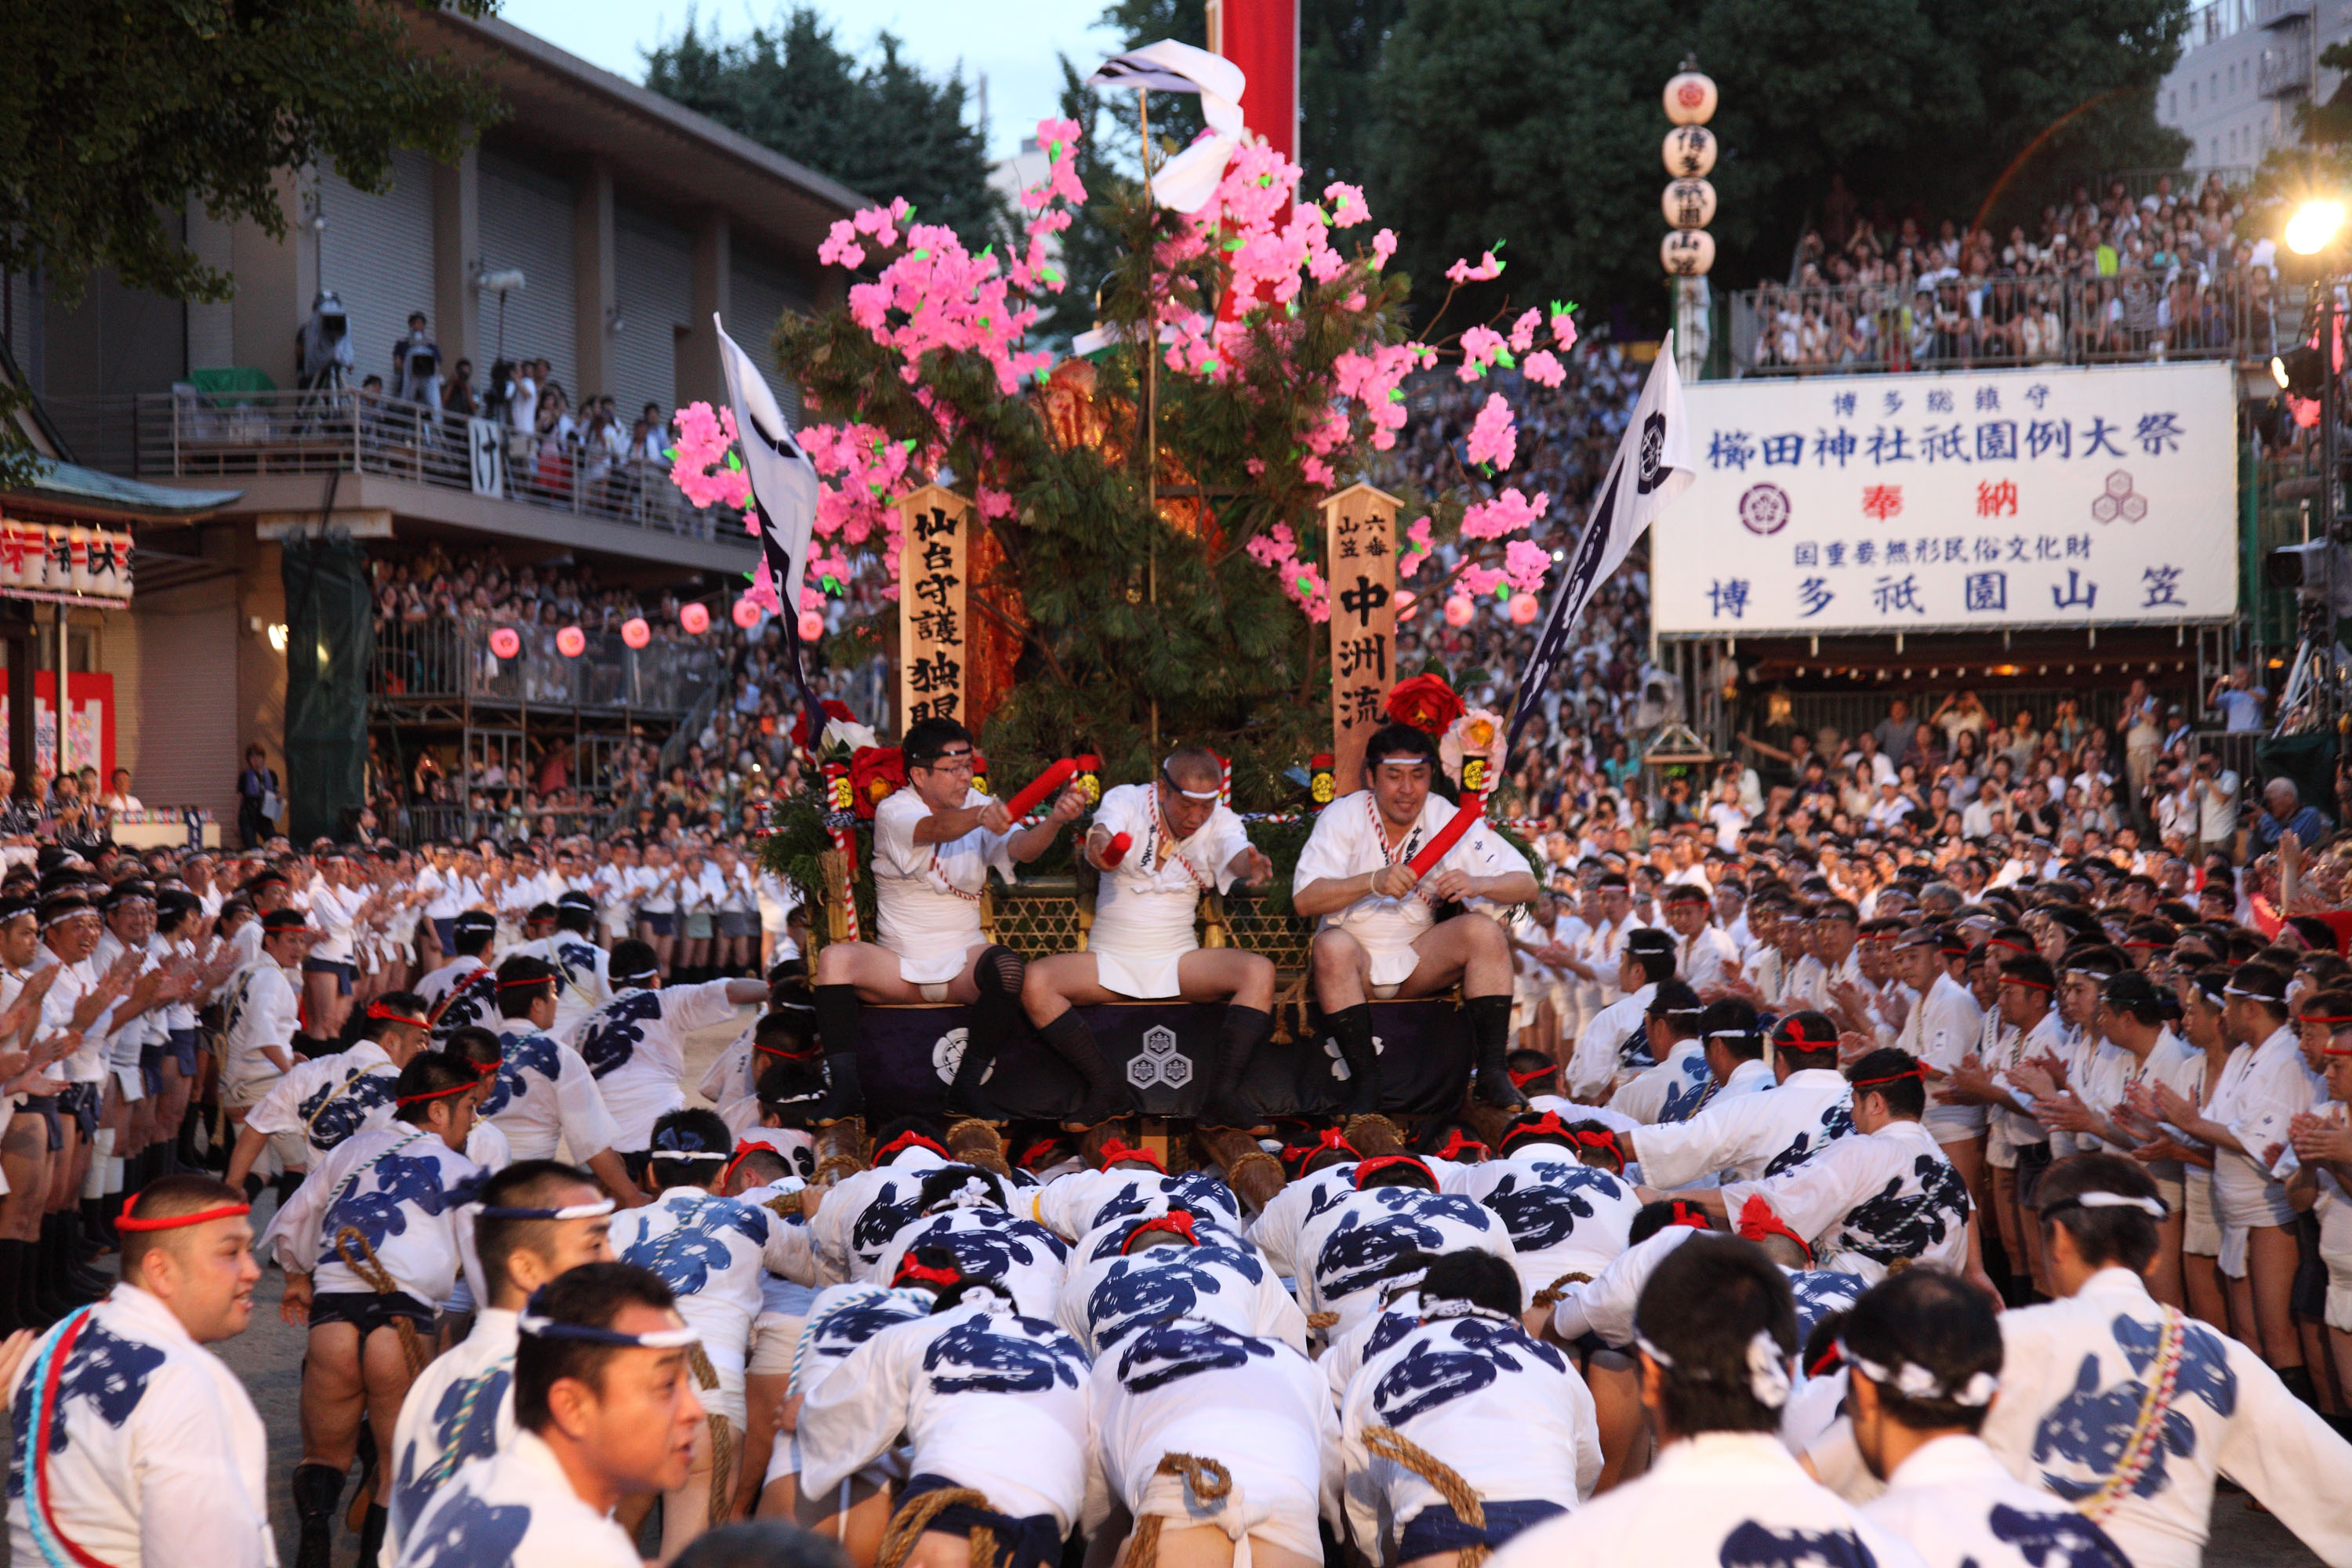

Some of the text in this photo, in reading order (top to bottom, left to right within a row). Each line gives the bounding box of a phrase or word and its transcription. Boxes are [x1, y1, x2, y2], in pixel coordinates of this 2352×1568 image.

[1706, 412, 2187, 472] 櫛田神社祇園例大祭
[1862, 480, 2019, 522] 奉納
[1337, 516, 1360, 559] 山笠
[1364, 514, 1390, 557] 六番
[1793, 532, 2093, 568] 国重要無形民俗文化財
[1706, 564, 2188, 619] 博多祇園山笠
[1338, 575, 1391, 730] 中洲流
